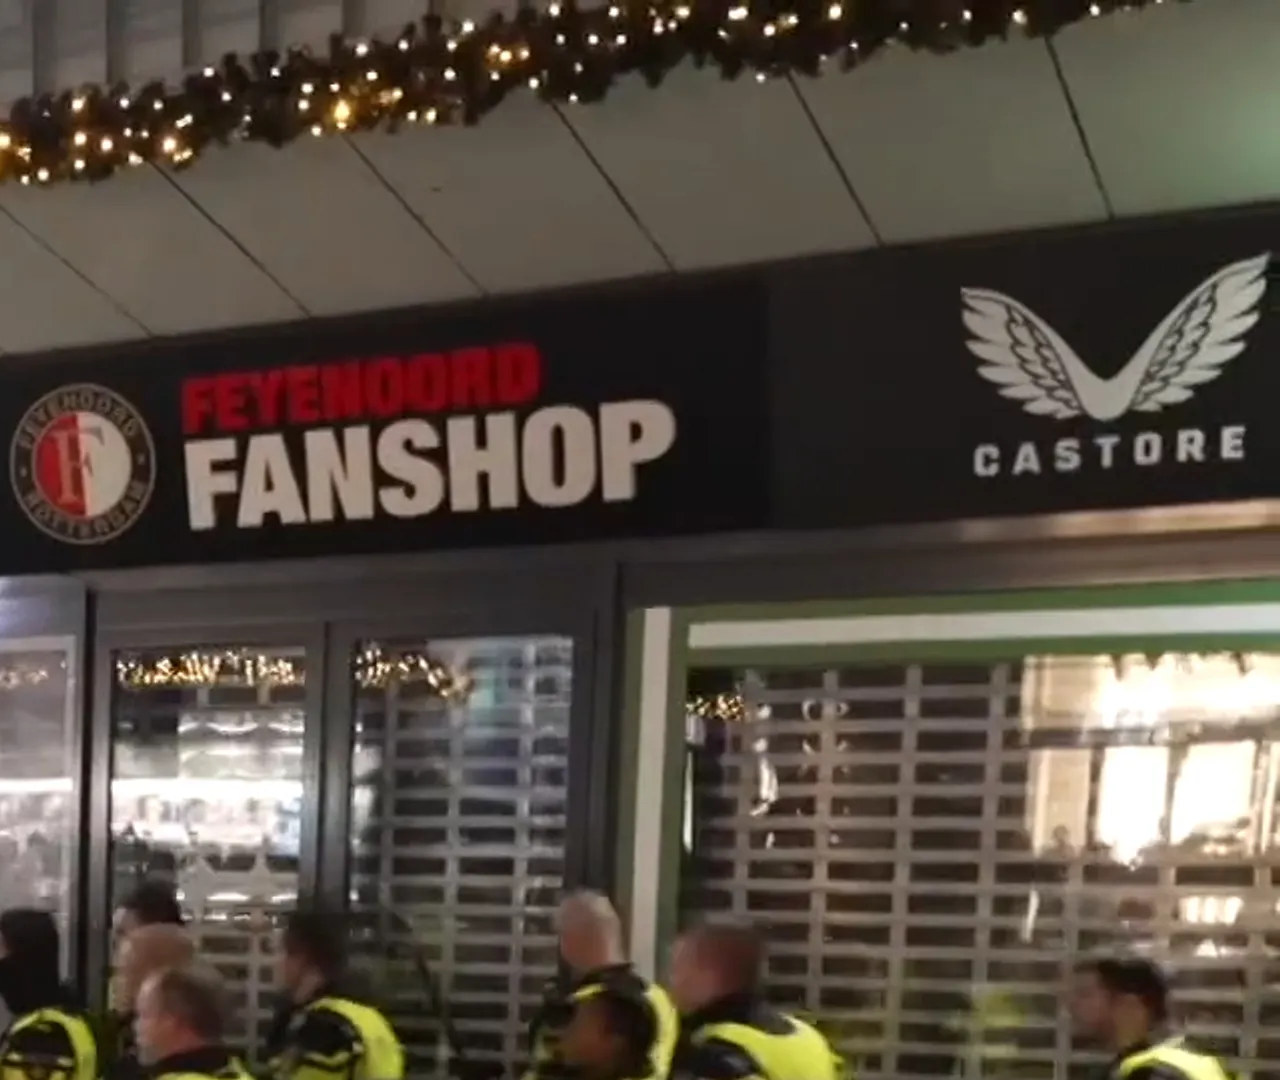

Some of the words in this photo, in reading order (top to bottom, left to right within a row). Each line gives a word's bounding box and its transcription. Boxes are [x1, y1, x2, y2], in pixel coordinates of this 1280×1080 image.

[181, 341, 544, 435] FEYENOORD
[183, 398, 677, 531] FANSHOP
[973, 424, 1247, 477] CASTORE
